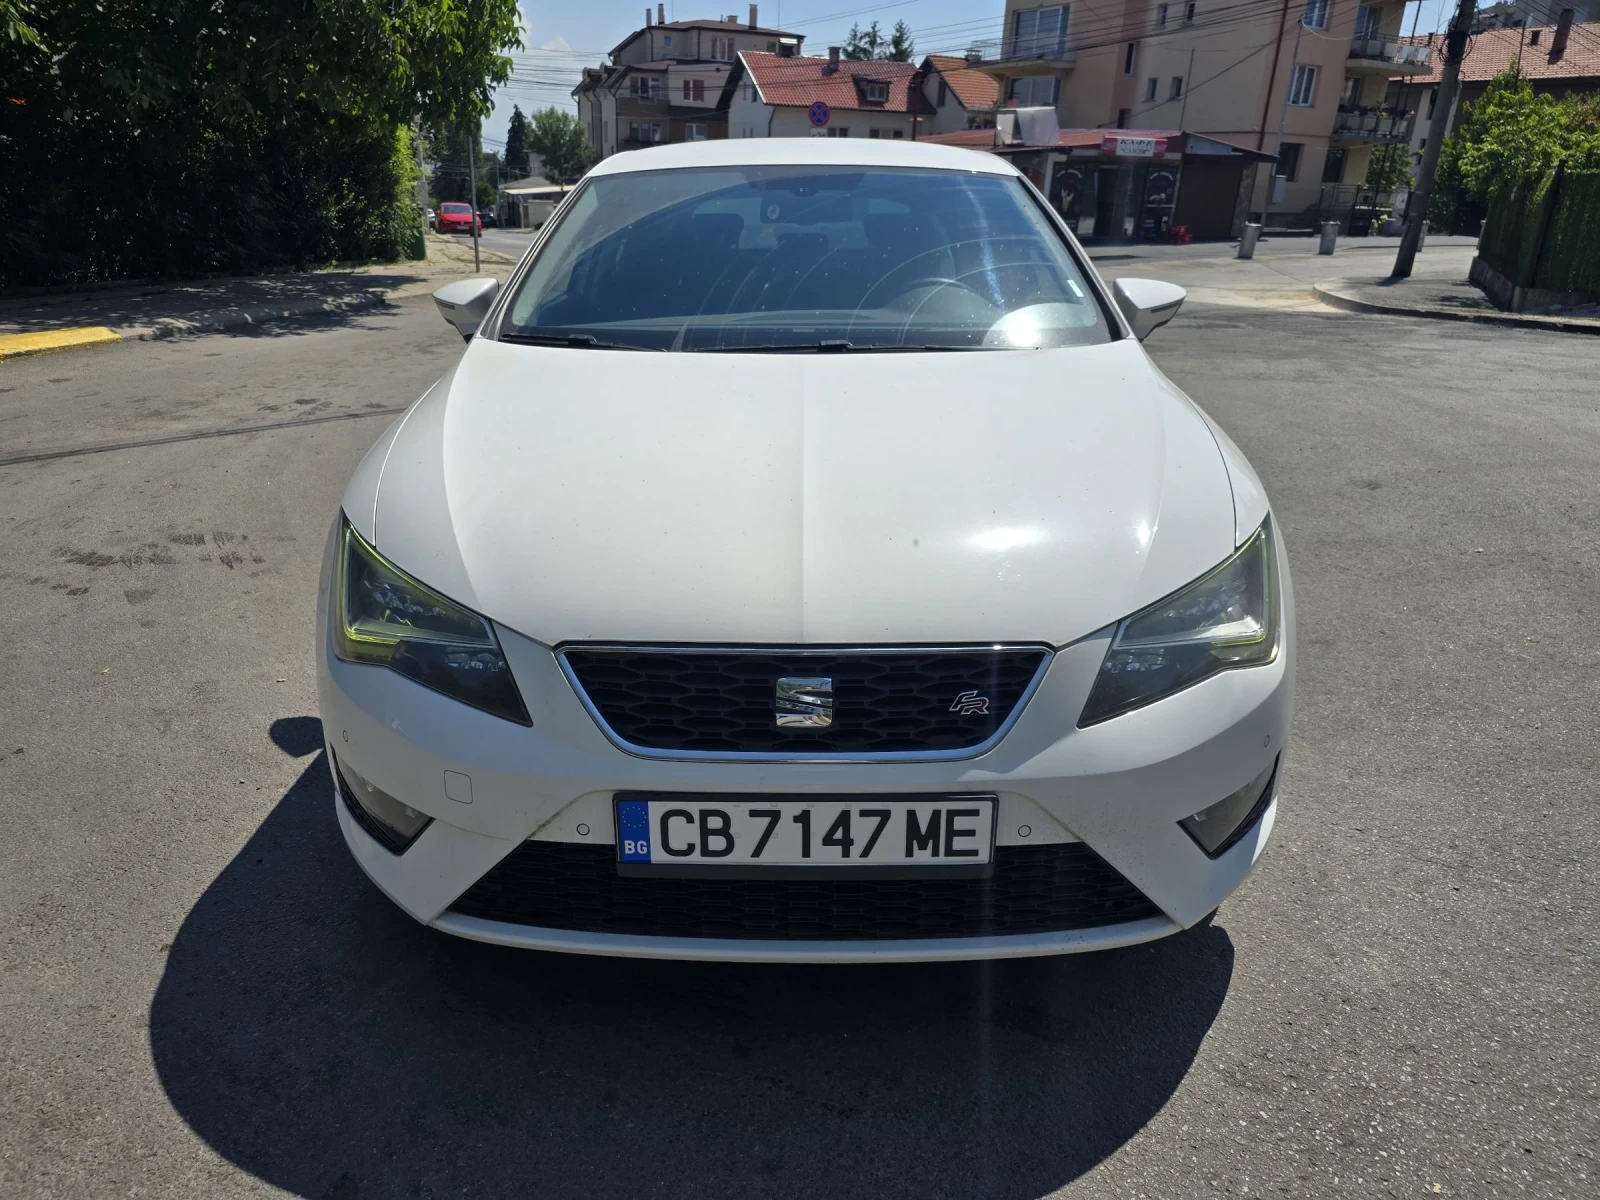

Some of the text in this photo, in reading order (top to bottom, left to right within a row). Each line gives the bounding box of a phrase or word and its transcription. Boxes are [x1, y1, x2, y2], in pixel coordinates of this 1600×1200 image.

[949, 690, 989, 715] FR
[660, 808, 980, 859] CB 7147 ME
[624, 840, 648, 854] BG
